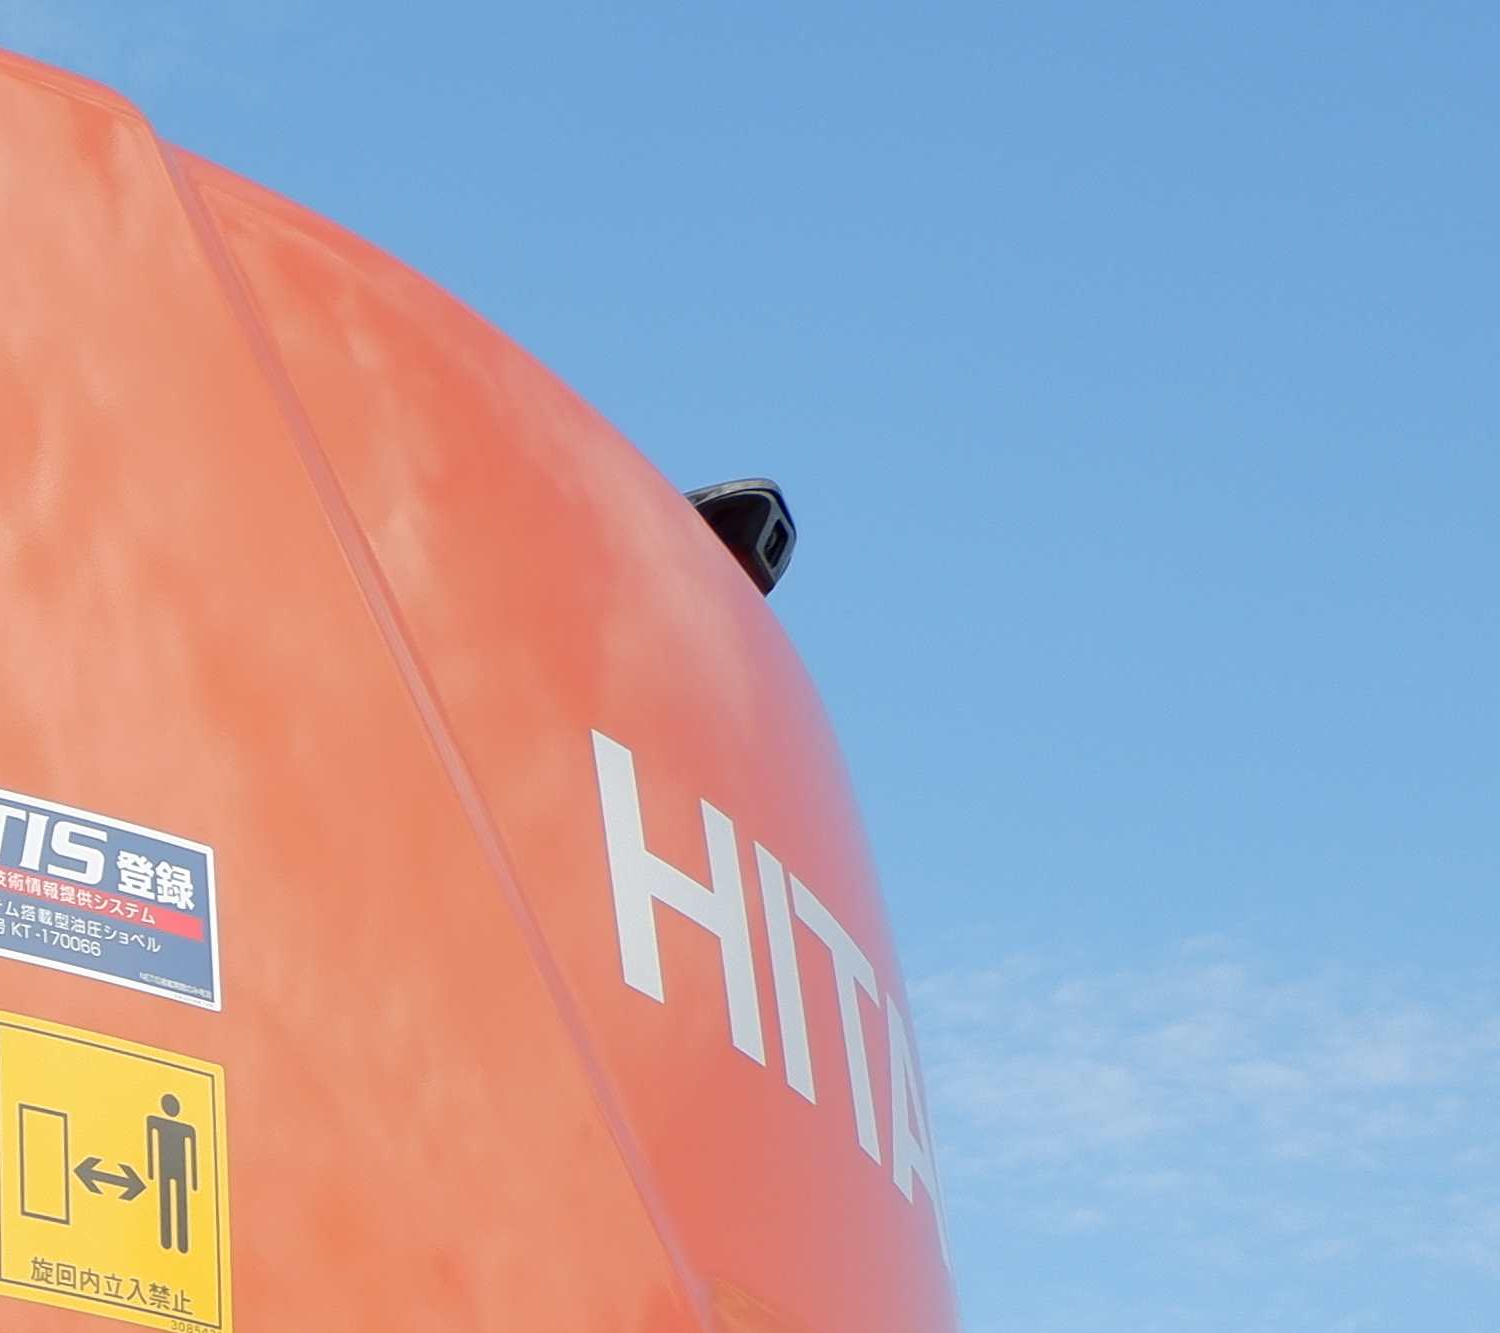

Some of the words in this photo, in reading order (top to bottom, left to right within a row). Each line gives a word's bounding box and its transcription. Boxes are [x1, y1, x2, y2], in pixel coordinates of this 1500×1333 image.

[116, 849, 195, 911] 登録
[30, 1255, 194, 1316] 旋回内立入禁止
